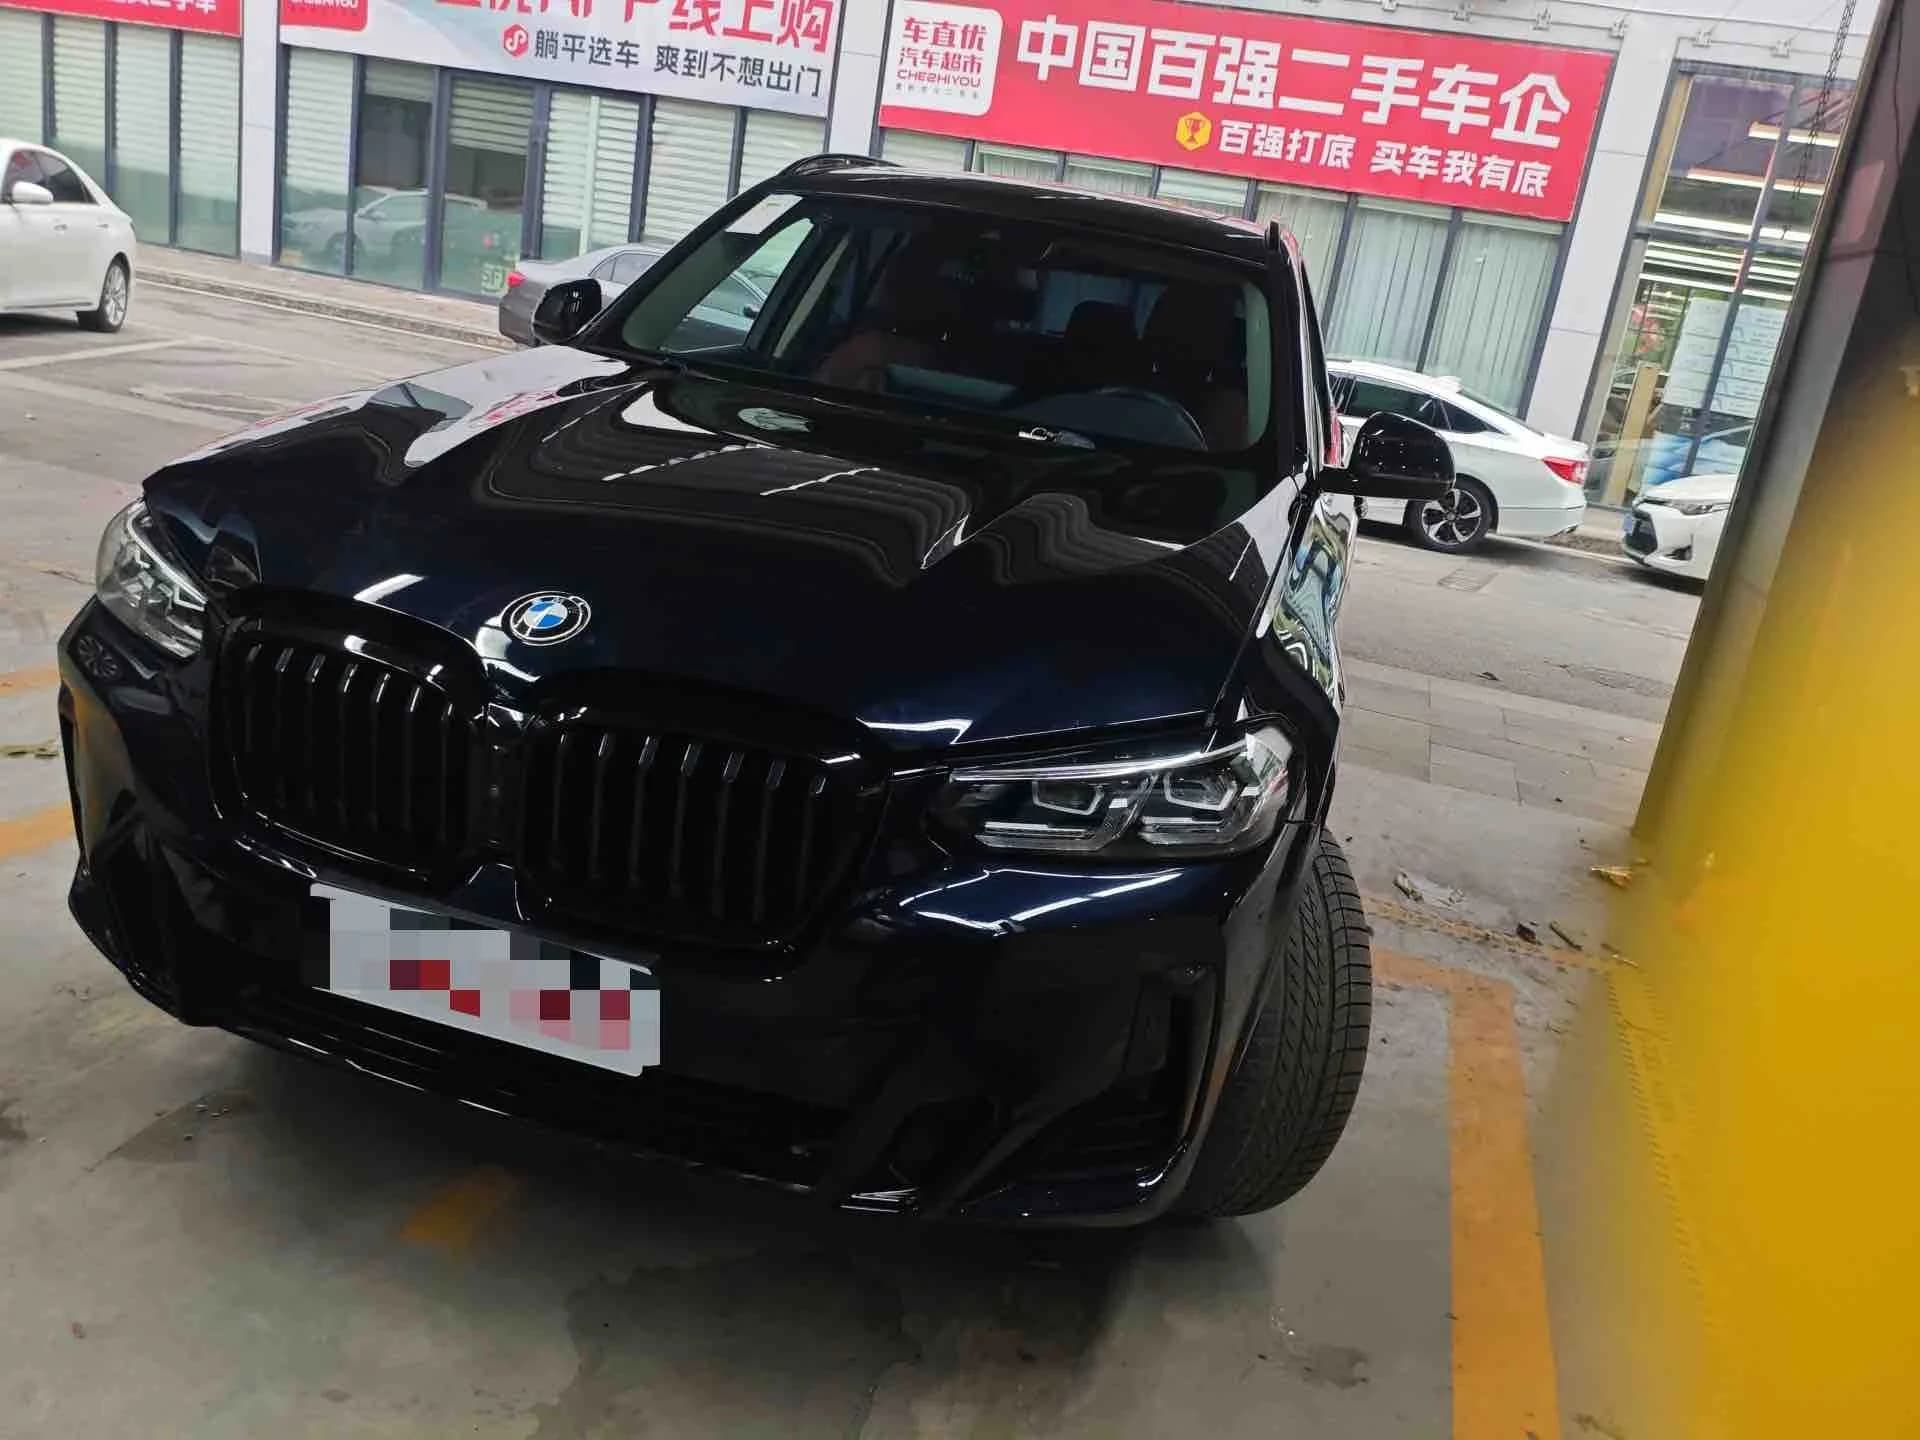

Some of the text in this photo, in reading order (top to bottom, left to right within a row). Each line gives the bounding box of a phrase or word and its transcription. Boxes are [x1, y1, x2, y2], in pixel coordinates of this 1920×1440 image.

[534, 30, 823, 97] 躺平选车 爽到不想出门
[899, 47, 983, 75] 汽车超市
[903, 17, 987, 52] 车直优
[1016, 14, 1571, 149] 中国百强二手车企
[1218, 119, 1553, 198] 百强打底 买车我有底
